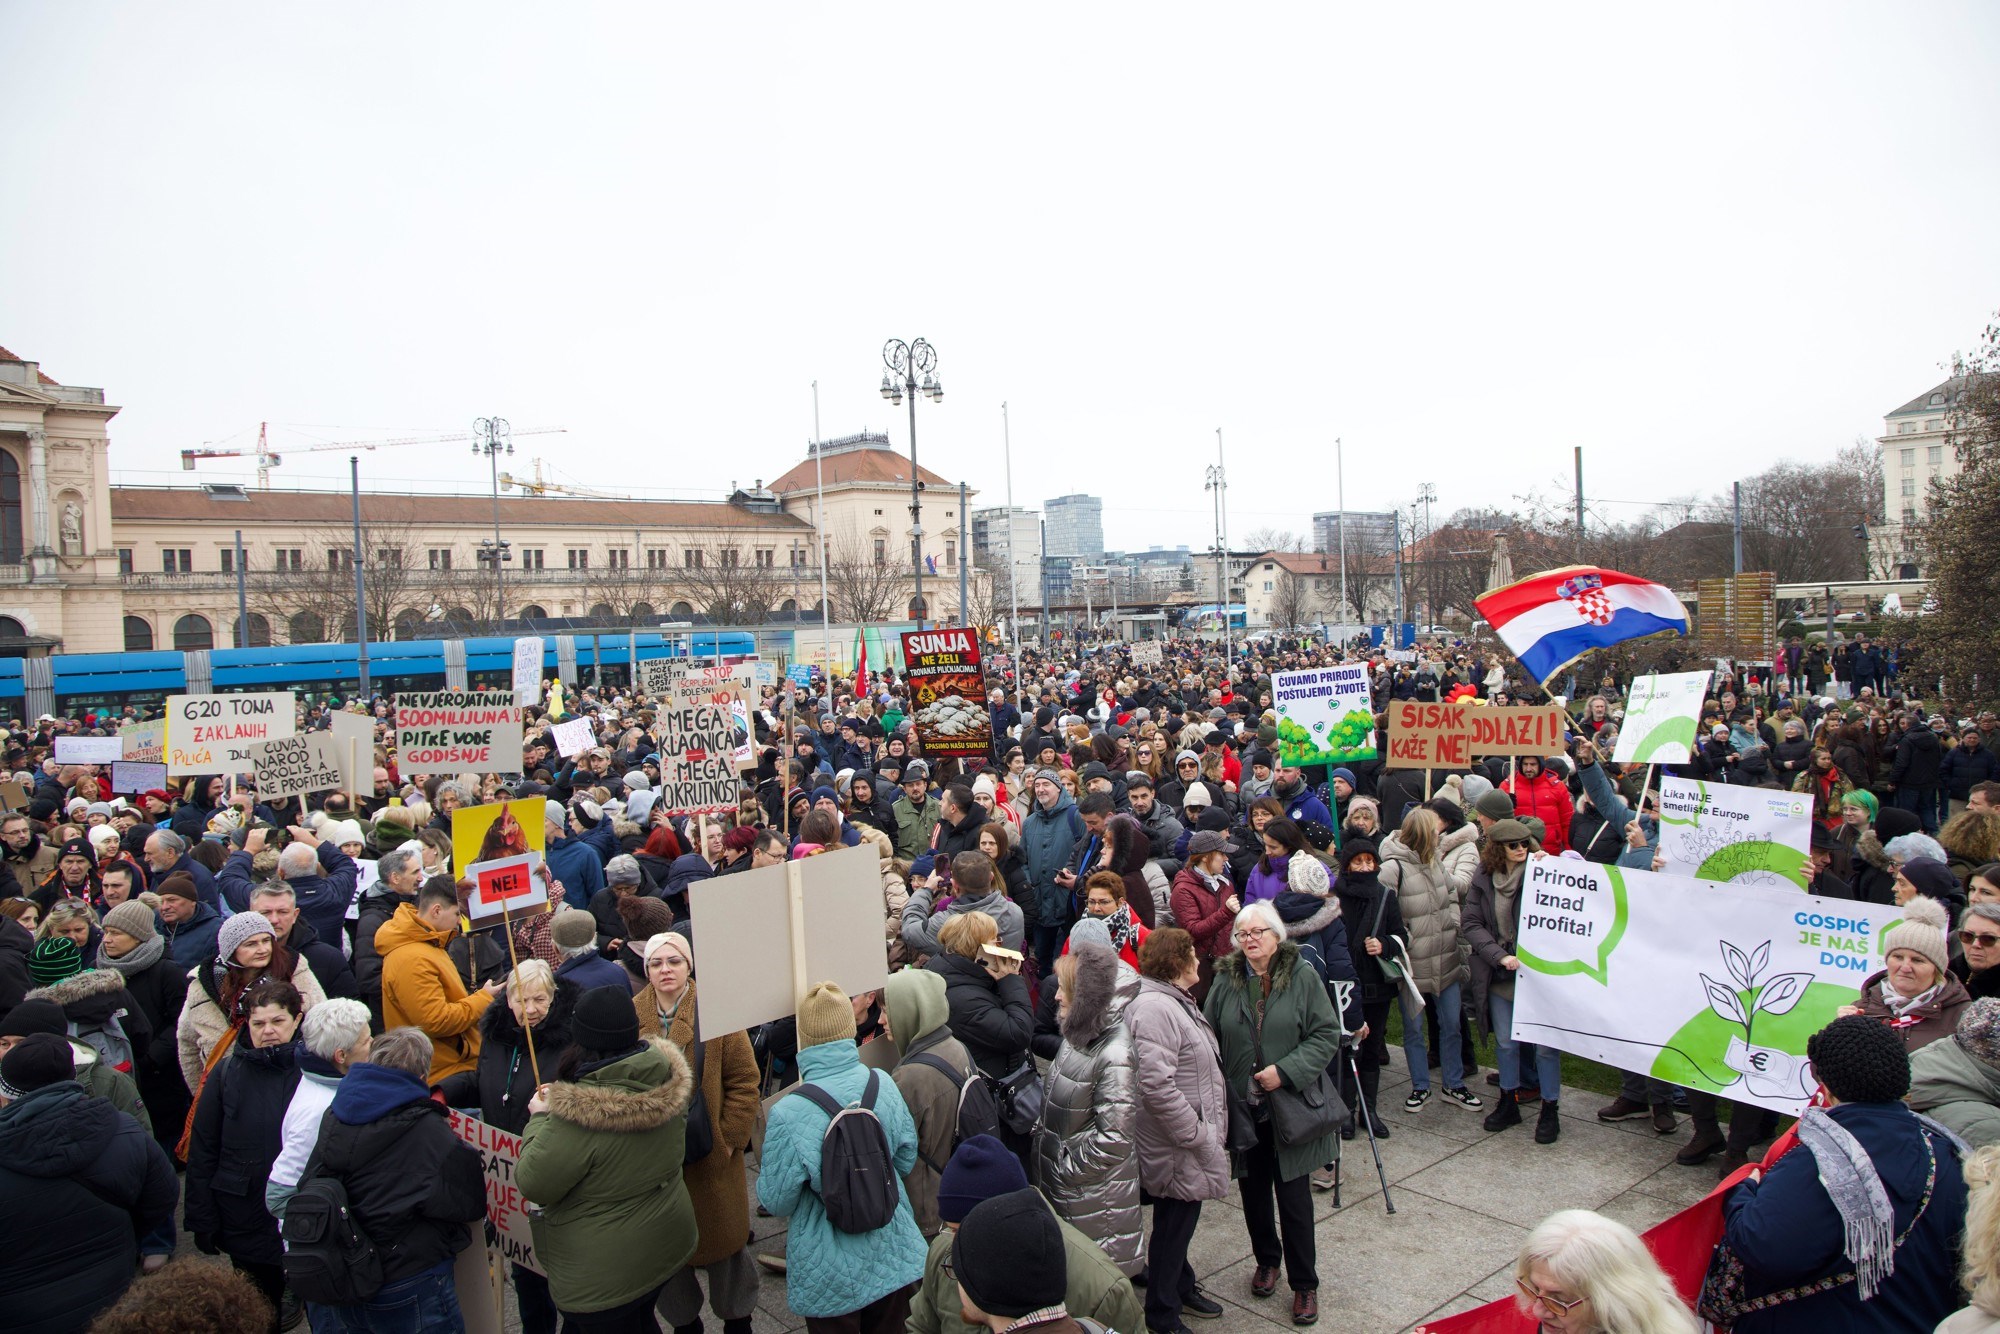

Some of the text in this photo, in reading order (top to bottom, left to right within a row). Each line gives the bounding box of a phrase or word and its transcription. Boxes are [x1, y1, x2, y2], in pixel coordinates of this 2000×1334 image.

[908, 633, 971, 655] SUNJA
[921, 653, 959, 666] NE ŽELI
[703, 666, 733, 679] STOP
[910, 666, 937, 677] TROVANJE
[1278, 669, 1362, 687] ČUVAMO PRIRODU
[398, 692, 514, 709] NEVJEROJATNIH
[681, 687, 715, 697] BOLESNI
[711, 692, 731, 705] NO
[1277, 682, 1367, 701] POŠTUJEMO ŽIVOTE
[184, 699, 274, 720] 620 TONA
[1400, 704, 1466, 730] SISAK
[667, 708, 724, 733] MEGA
[193, 723, 267, 742] ZAKLANIH
[402, 729, 492, 747] PITKE VODE
[264, 737, 307, 754] ČUVAJ
[407, 746, 491, 764] GODIŠNJE
[659, 730, 735, 759] KLAONICA
[925, 741, 988, 750] SPASIMO NAŠU SUNJU!
[1391, 733, 1471, 764] KAŽE NE!
[172, 746, 212, 767] PILIĆA
[254, 748, 322, 770] NAROD I
[319, 761, 327, 771] A
[677, 757, 731, 782] MEGA
[260, 770, 340, 795] NE PROFITERE
[1663, 789, 1712, 803] Lika NIJE
[1663, 800, 1750, 822] smetlište Europe
[491, 874, 518, 894] NE!
[1532, 865, 1599, 892] Priroda
[1535, 888, 1585, 913] iznad
[1527, 911, 1593, 938] profita!
[1794, 911, 1871, 936] GOSPIĆ
[1798, 931, 1870, 954] JE NAŠ
[1820, 951, 1868, 973] DOM
[487, 1203, 511, 1231] NE
